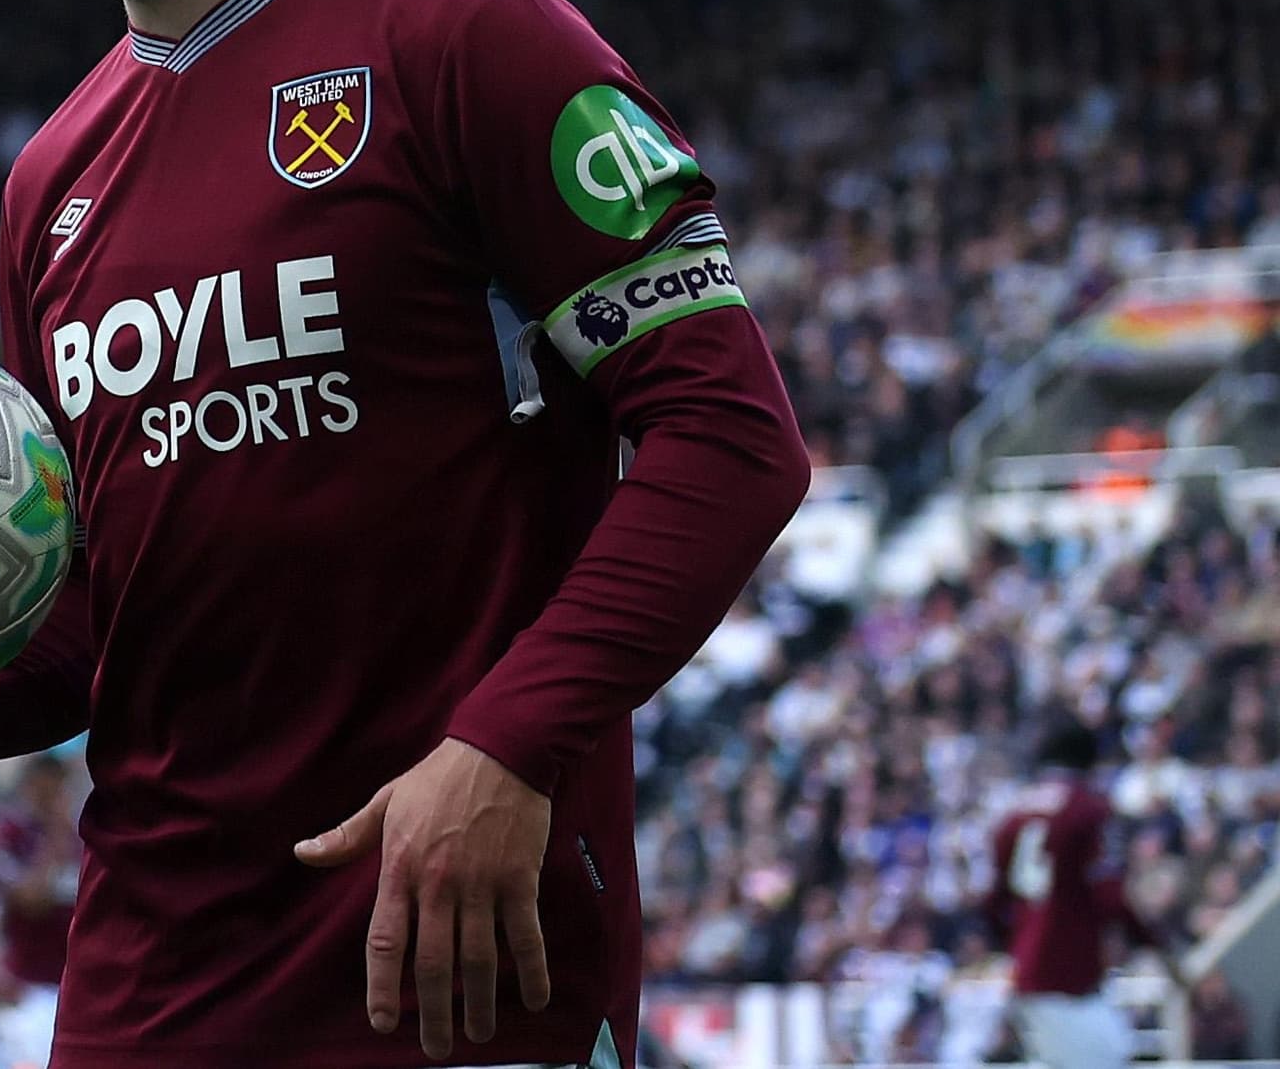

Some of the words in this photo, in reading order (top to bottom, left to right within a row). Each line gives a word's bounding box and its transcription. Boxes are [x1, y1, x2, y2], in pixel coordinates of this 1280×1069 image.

[282, 80, 322, 102] WEST
[324, 74, 359, 91] HAM
[299, 89, 344, 107] UNITED
[295, 167, 334, 179] LONDON
[52, 254, 345, 421] BOYLE
[142, 371, 359, 468] SPORTS
